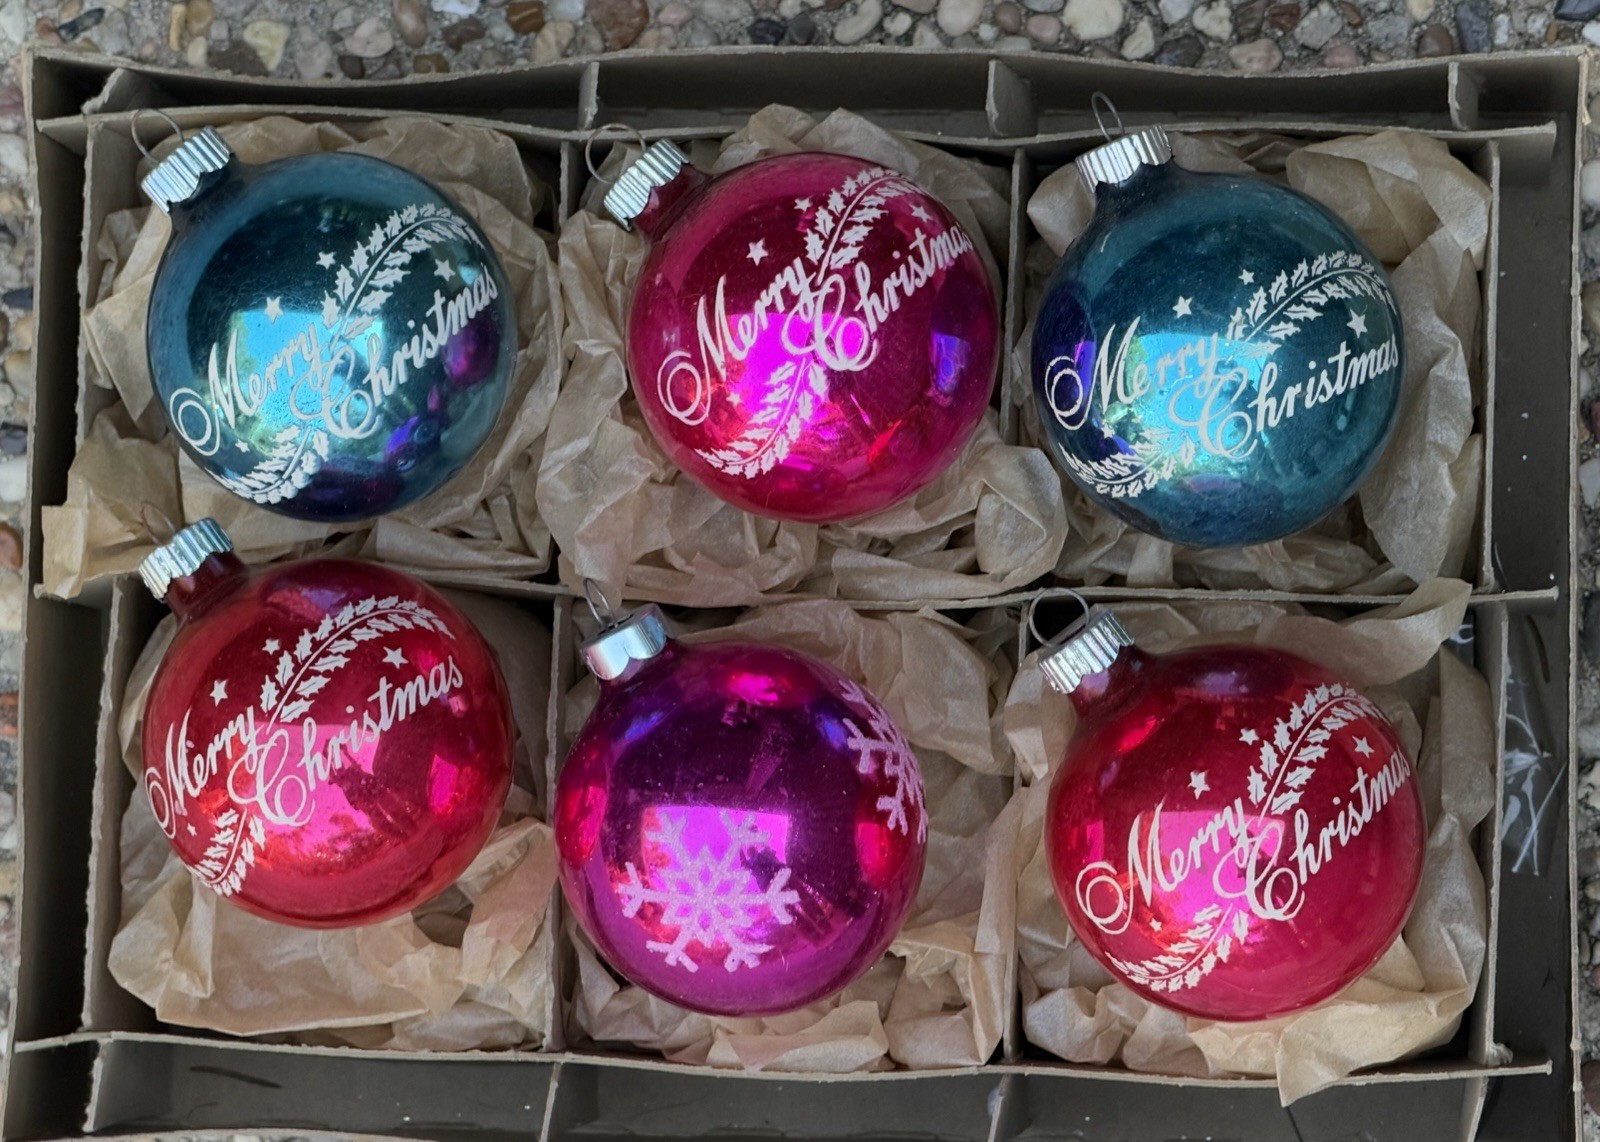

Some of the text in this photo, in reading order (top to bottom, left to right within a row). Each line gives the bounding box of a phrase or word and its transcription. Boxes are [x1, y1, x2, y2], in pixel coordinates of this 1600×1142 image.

[170, 262, 498, 456] Merry Christmas
[657, 257, 820, 426] Merry
[1045, 316, 1399, 459] Merry Christmas
[145, 656, 463, 839] Merry Christmas
[1075, 745, 1411, 935] Merry Christmas
